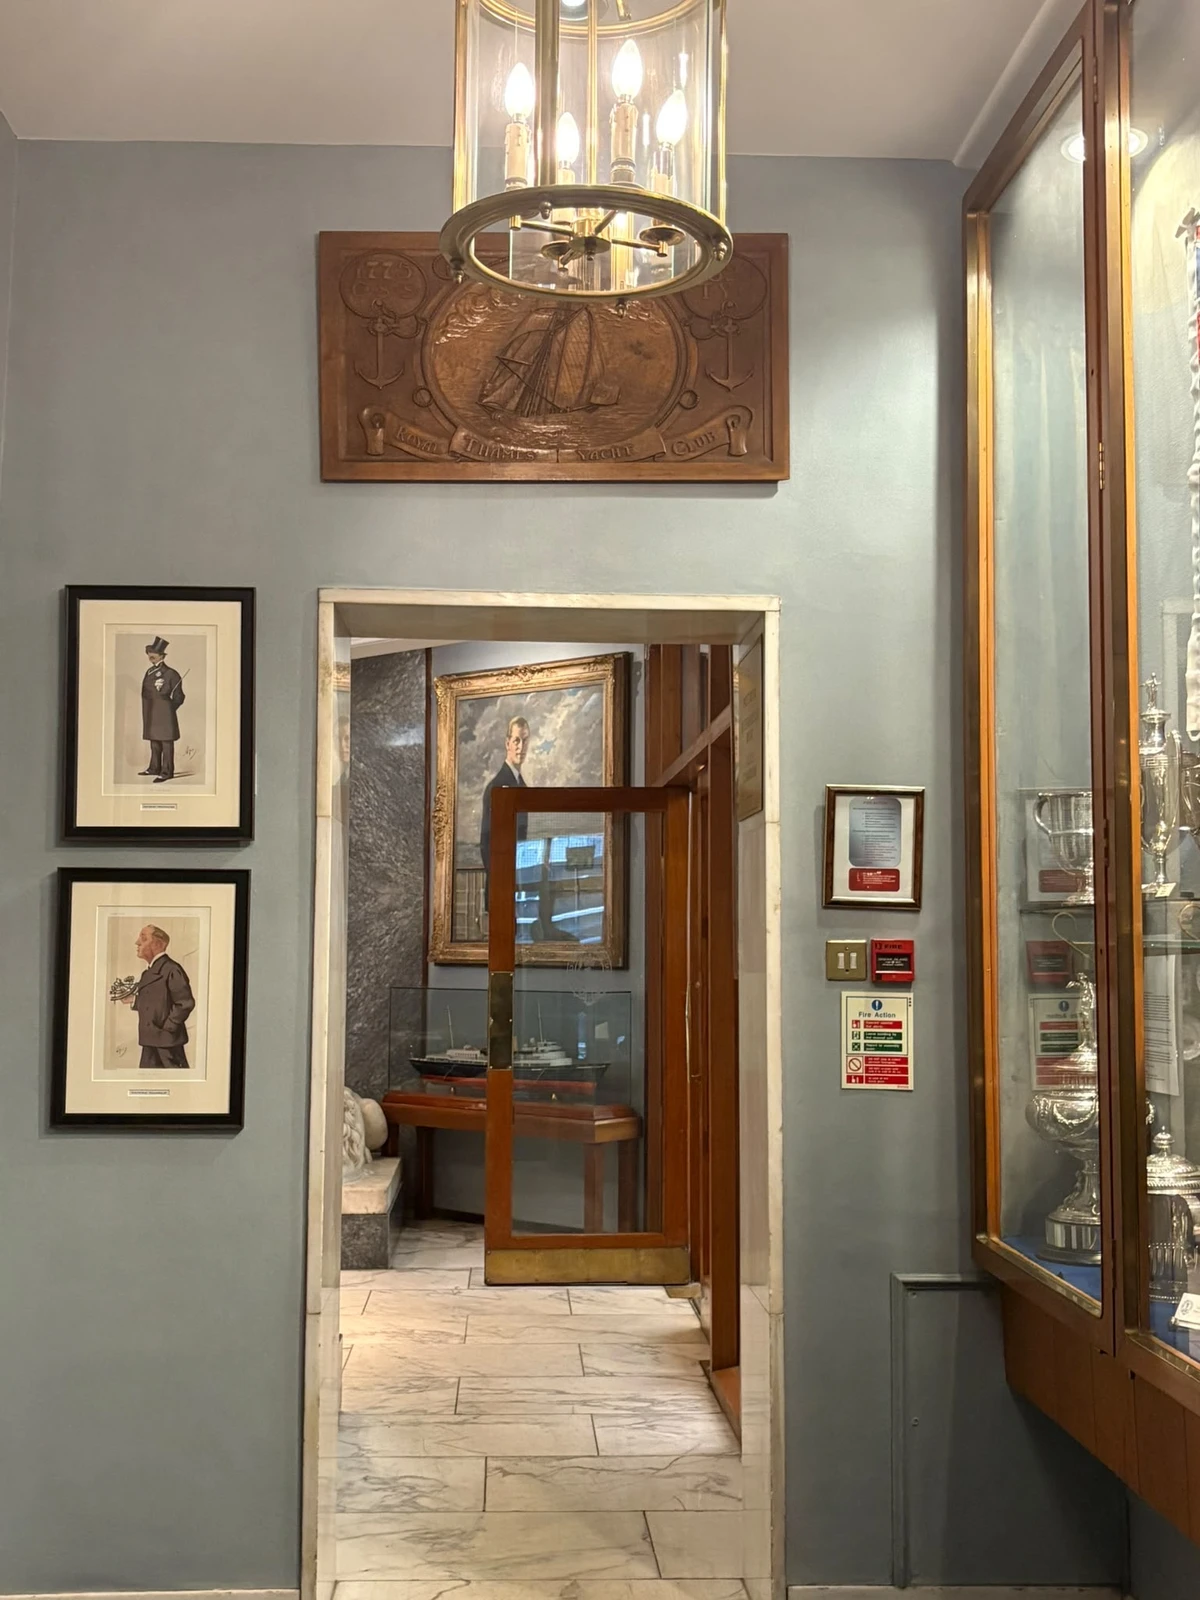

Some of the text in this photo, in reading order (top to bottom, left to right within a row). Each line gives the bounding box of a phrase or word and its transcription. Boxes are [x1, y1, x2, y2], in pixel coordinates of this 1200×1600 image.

[463, 436, 536, 460] THAMES
[575, 445, 634, 462] YACHT
[672, 432, 718, 456] CLUB
